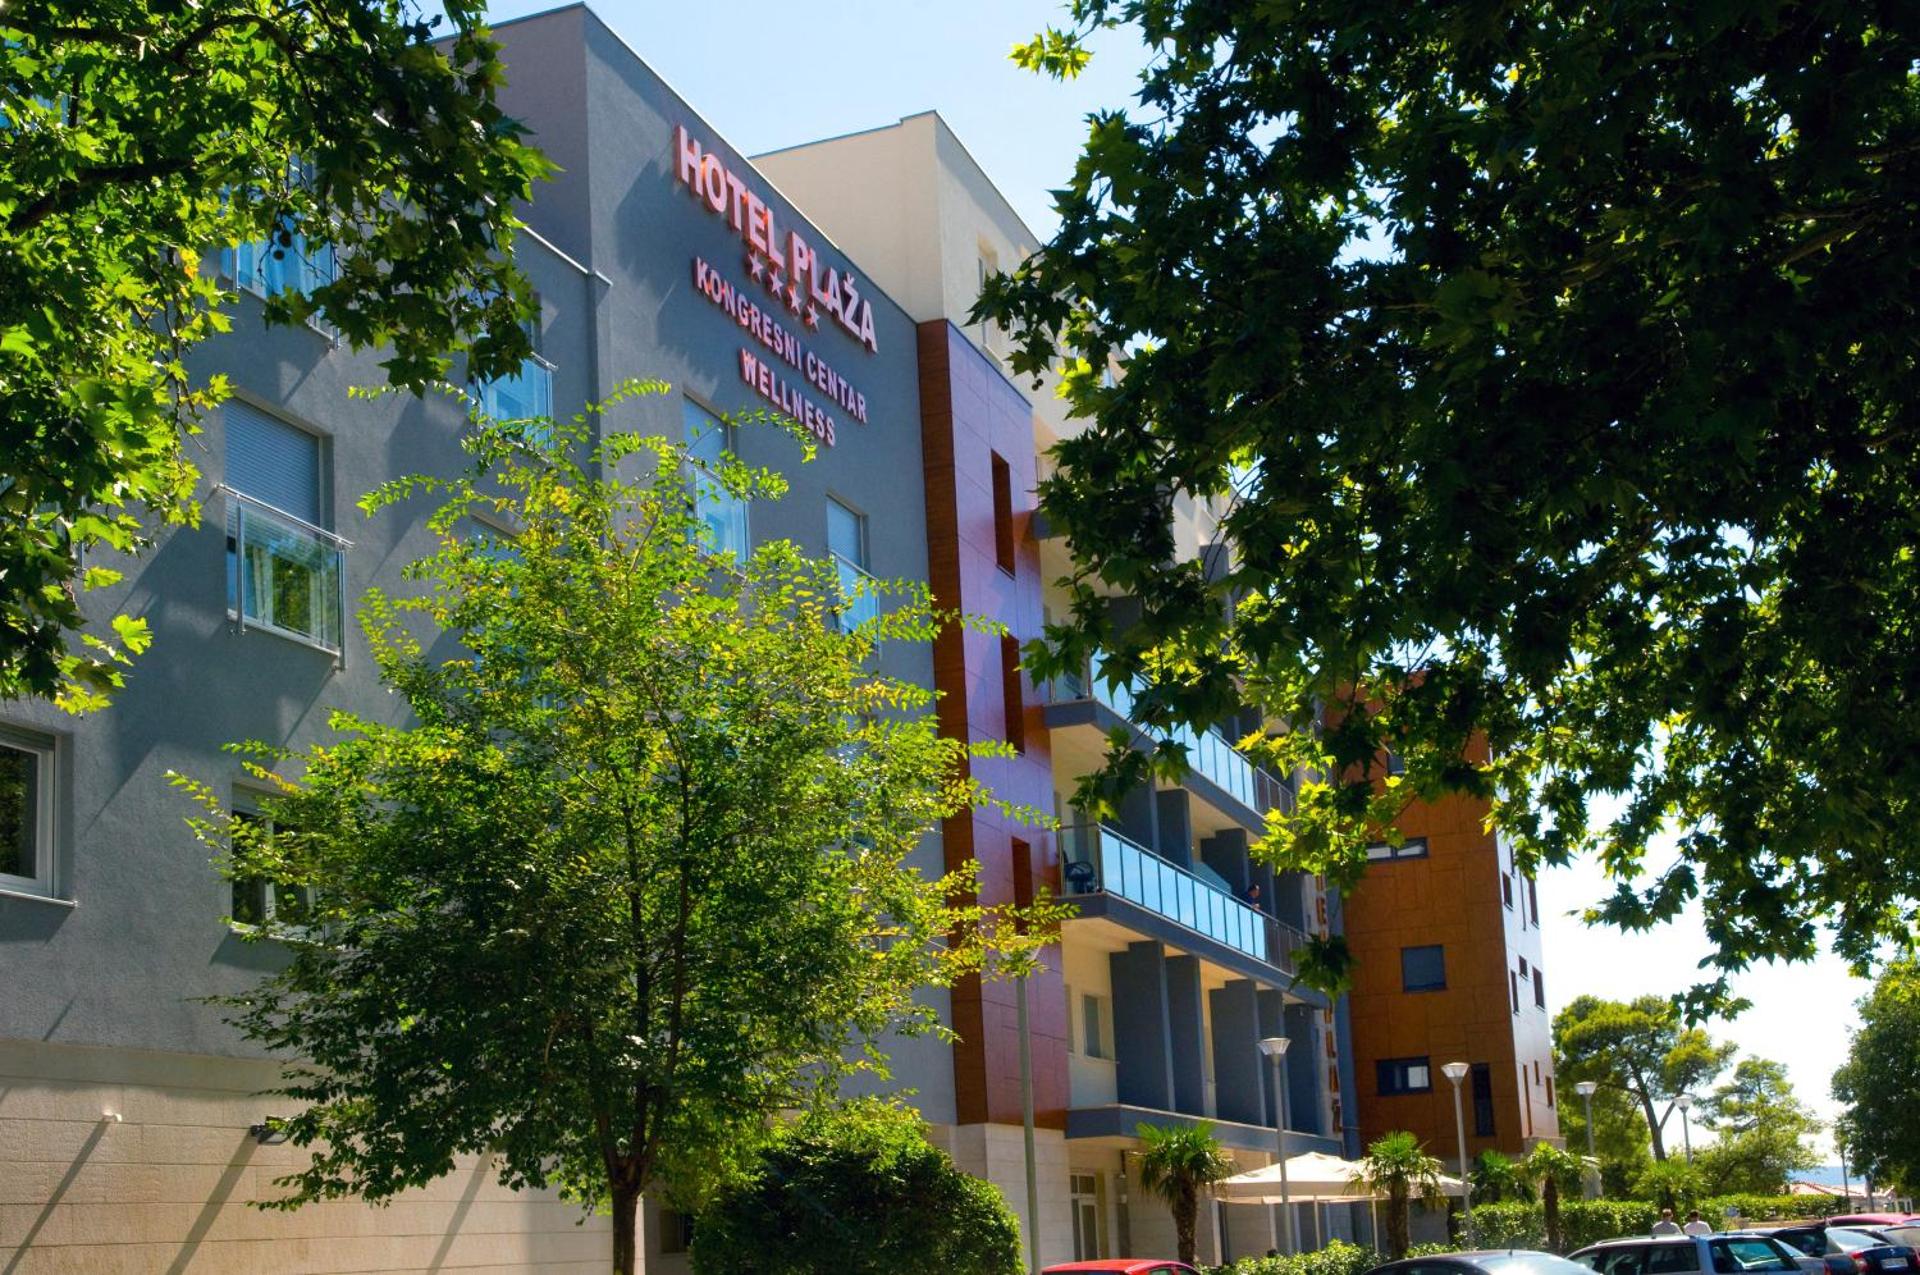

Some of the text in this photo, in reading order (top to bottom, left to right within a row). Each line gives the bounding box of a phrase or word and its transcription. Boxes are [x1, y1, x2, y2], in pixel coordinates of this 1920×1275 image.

[676, 124, 879, 353] HOTEL PLAŽA
[694, 256, 868, 424] KONGRESNI CENTAR
[740, 347, 836, 447] WELLNESS
